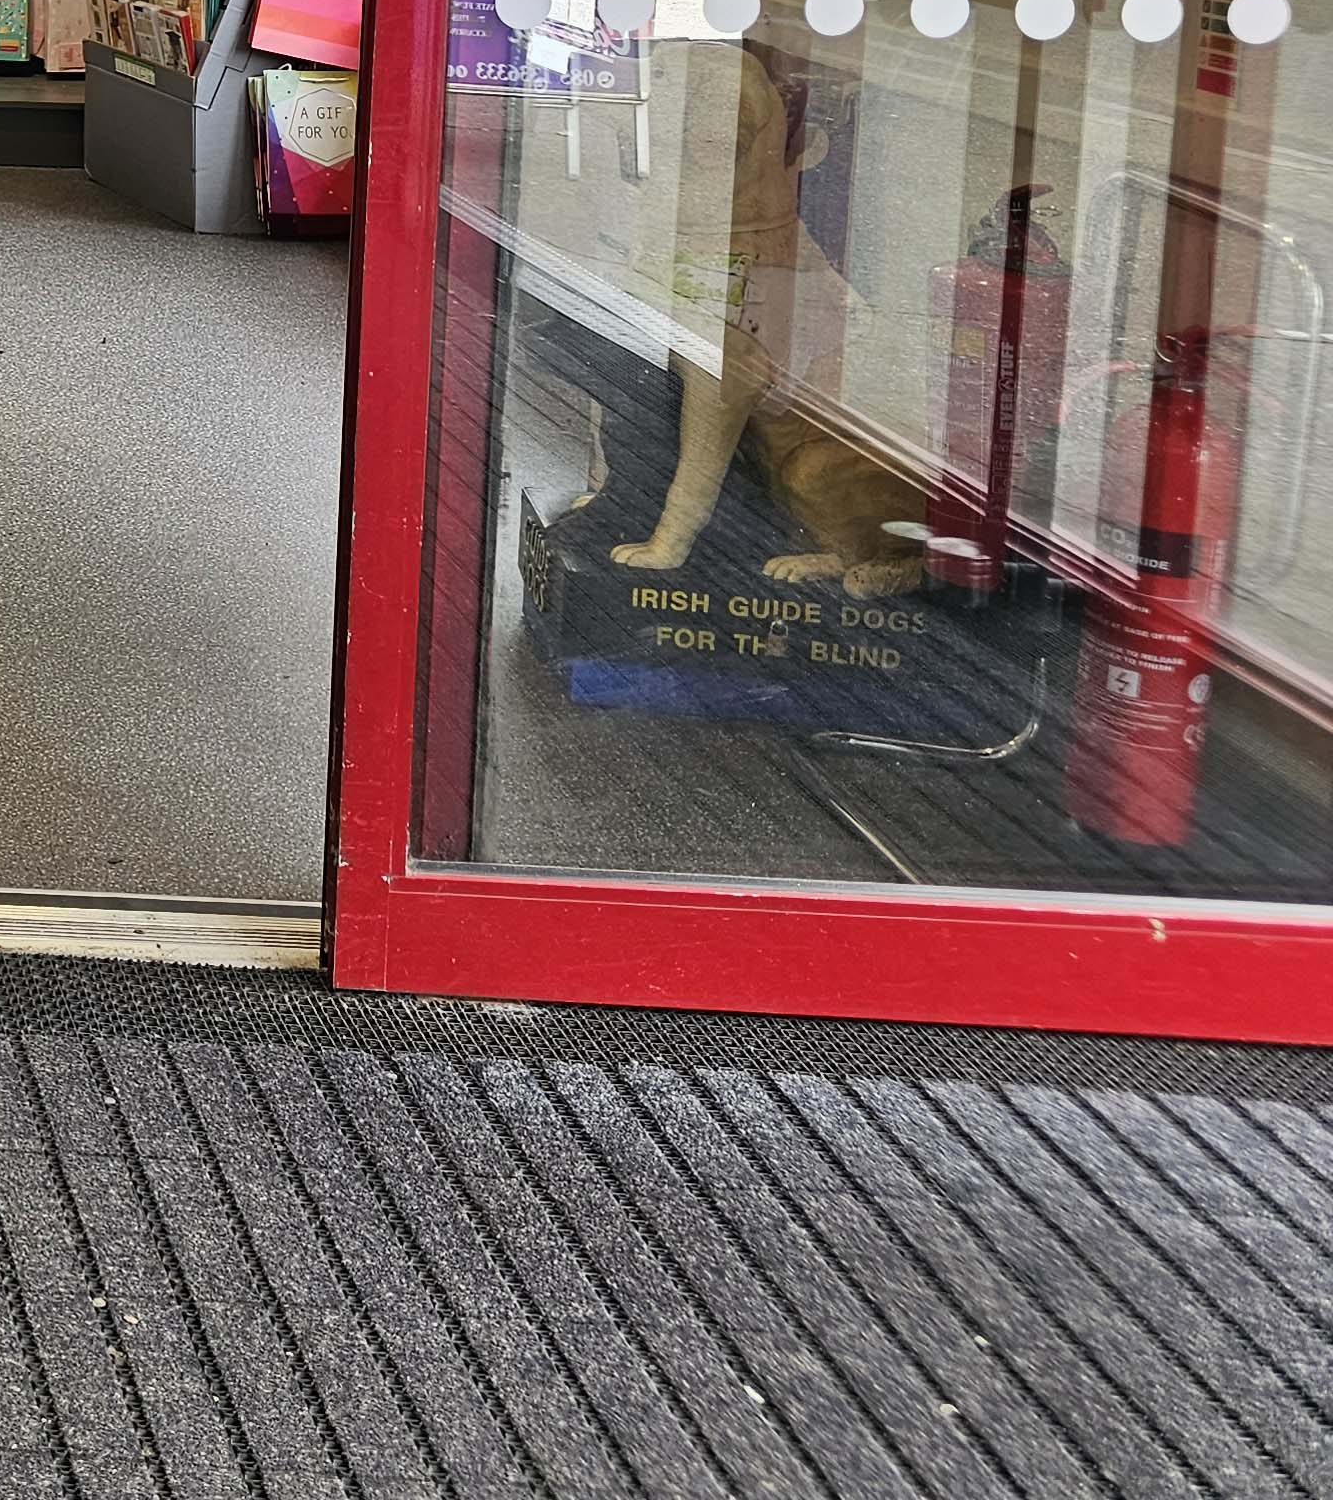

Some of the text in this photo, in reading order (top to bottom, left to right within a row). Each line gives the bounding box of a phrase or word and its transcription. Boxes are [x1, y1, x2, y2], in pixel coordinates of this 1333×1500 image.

[300, 107, 342, 120] A GIF
[297, 126, 323, 139] FOR
[632, 586, 927, 635] IRISH GUIDE DOGS
[656, 626, 901, 670] FOR TH BLIND
